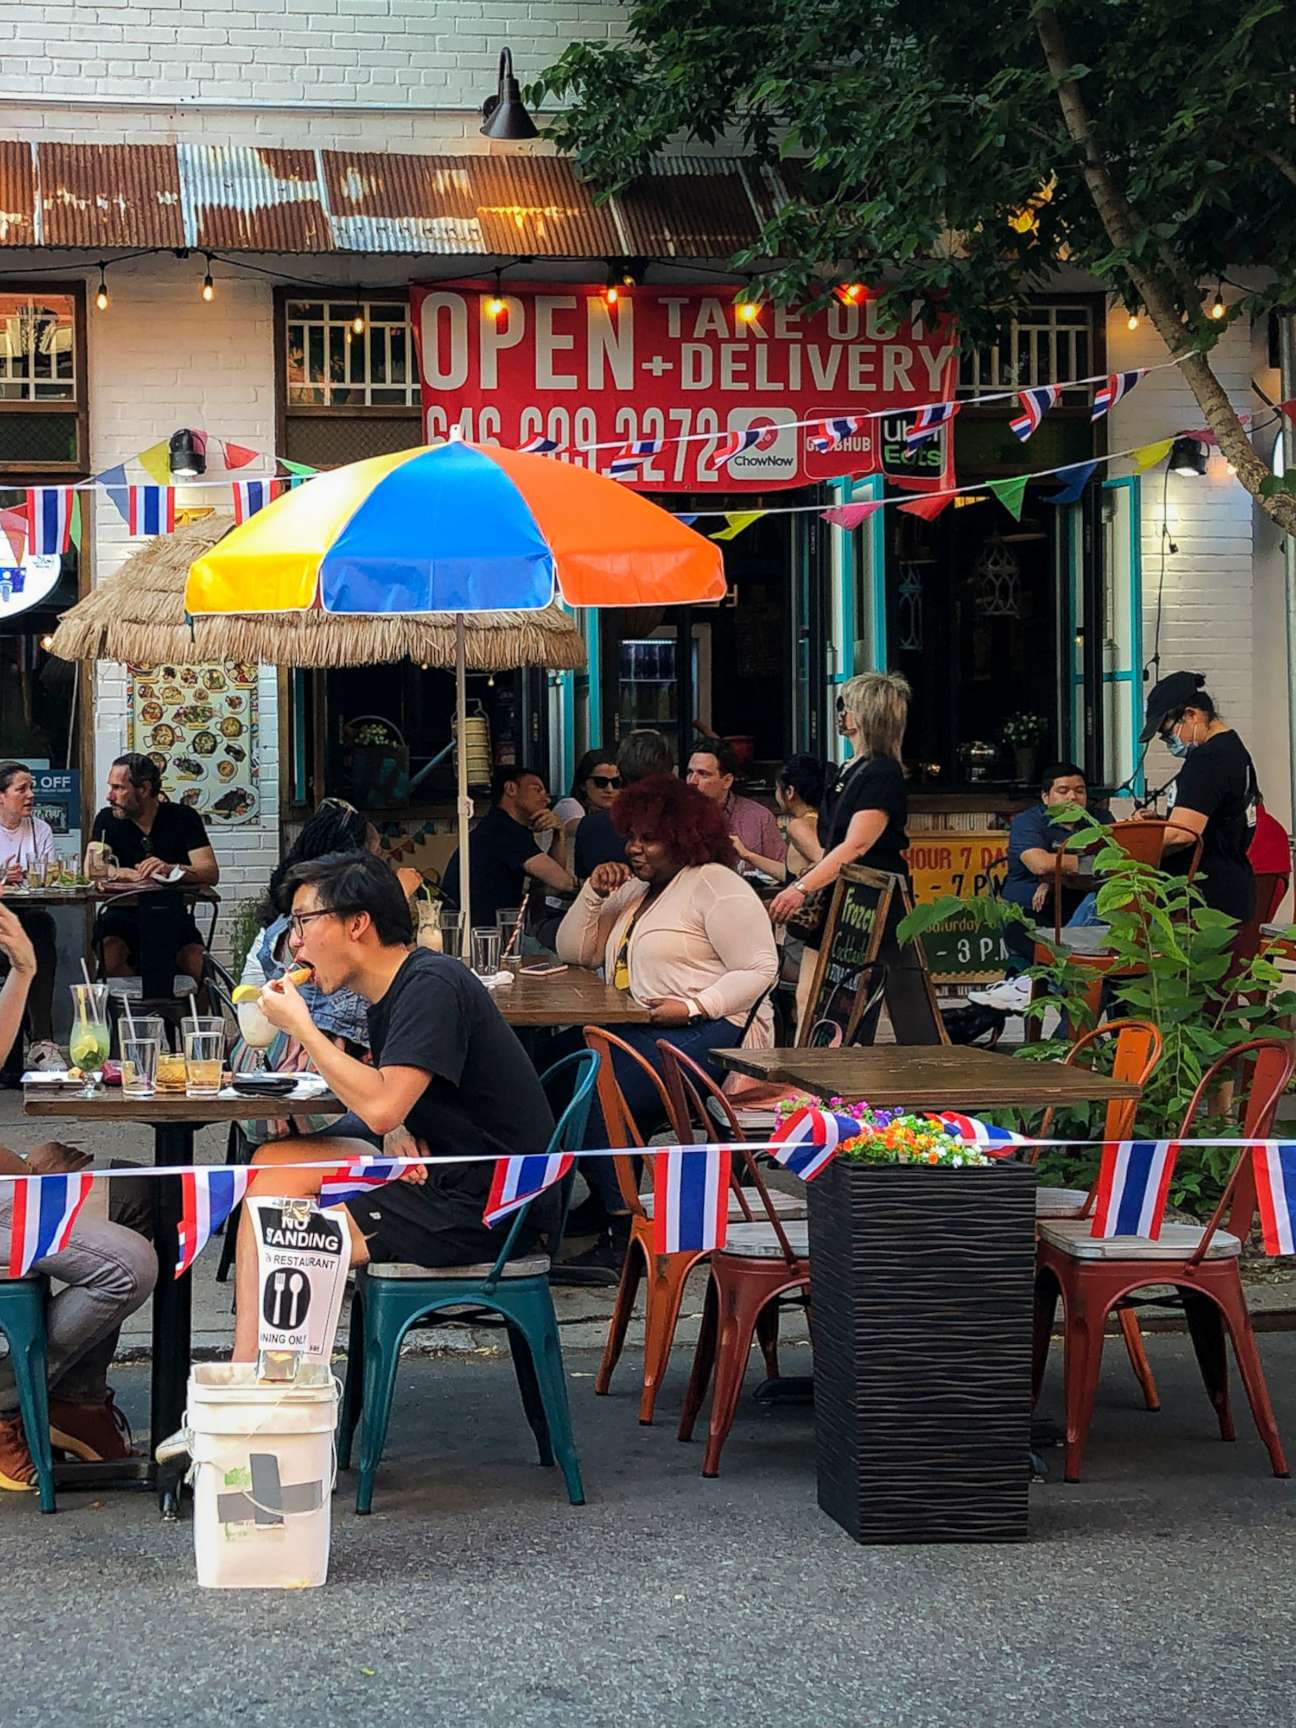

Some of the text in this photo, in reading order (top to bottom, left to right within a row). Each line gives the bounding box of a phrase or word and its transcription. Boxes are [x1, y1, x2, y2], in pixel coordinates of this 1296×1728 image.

[658, 297, 803, 339] TAKE
[420, 291, 634, 391] OPEN
[884, 419, 943, 443] Ubr
[806, 436, 871, 452] GBHUB
[734, 454, 794, 468] ChowNow
[40, 775, 71, 789] OFF
[959, 847, 972, 870] 7
[951, 873, 964, 897] 7
[956, 938, 972, 963] 3
[266, 1227, 339, 1251] SANDING
